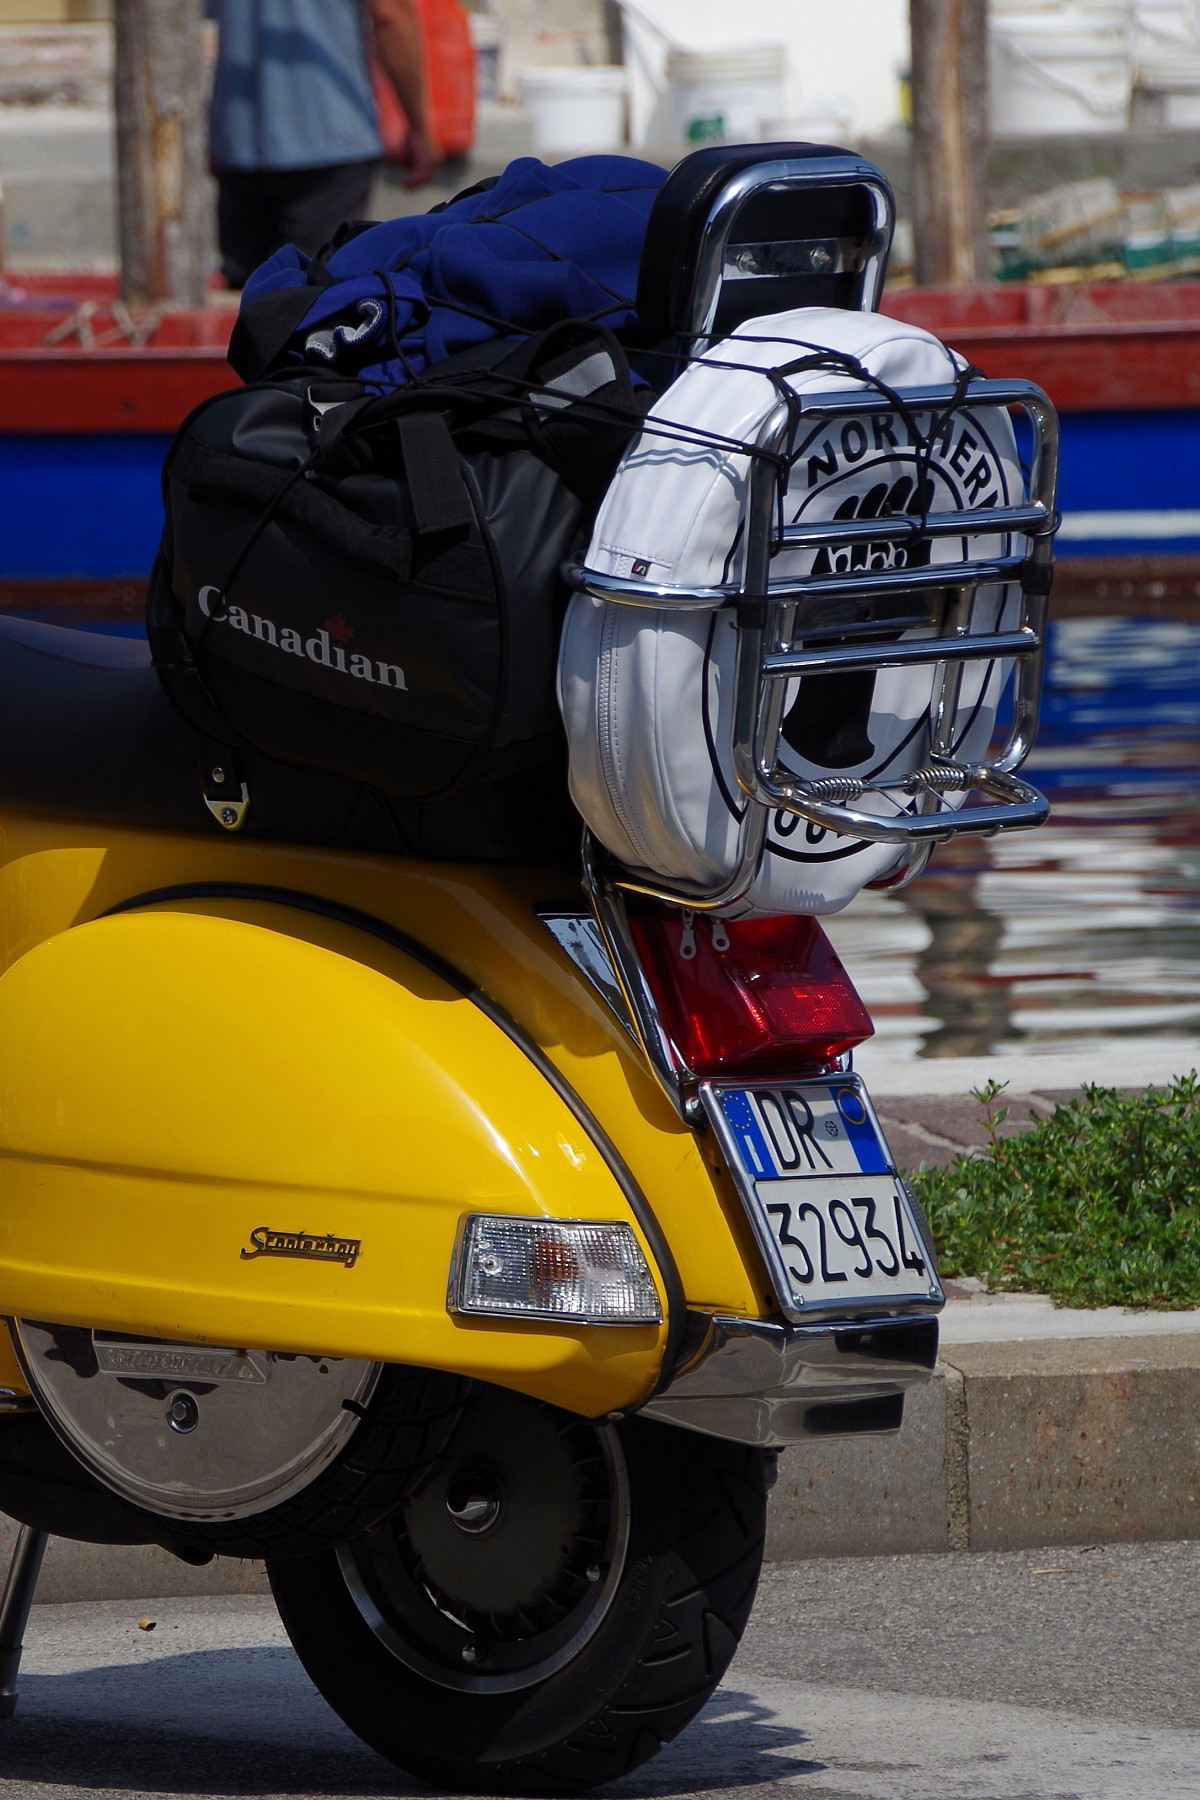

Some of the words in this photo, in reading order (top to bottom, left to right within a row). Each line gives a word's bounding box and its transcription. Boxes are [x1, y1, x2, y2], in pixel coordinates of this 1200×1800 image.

[807, 410, 998, 538] NORTHER
[198, 586, 408, 690] Canadian
[753, 1090, 833, 1170] DR
[765, 1196, 925, 1284] 32934
